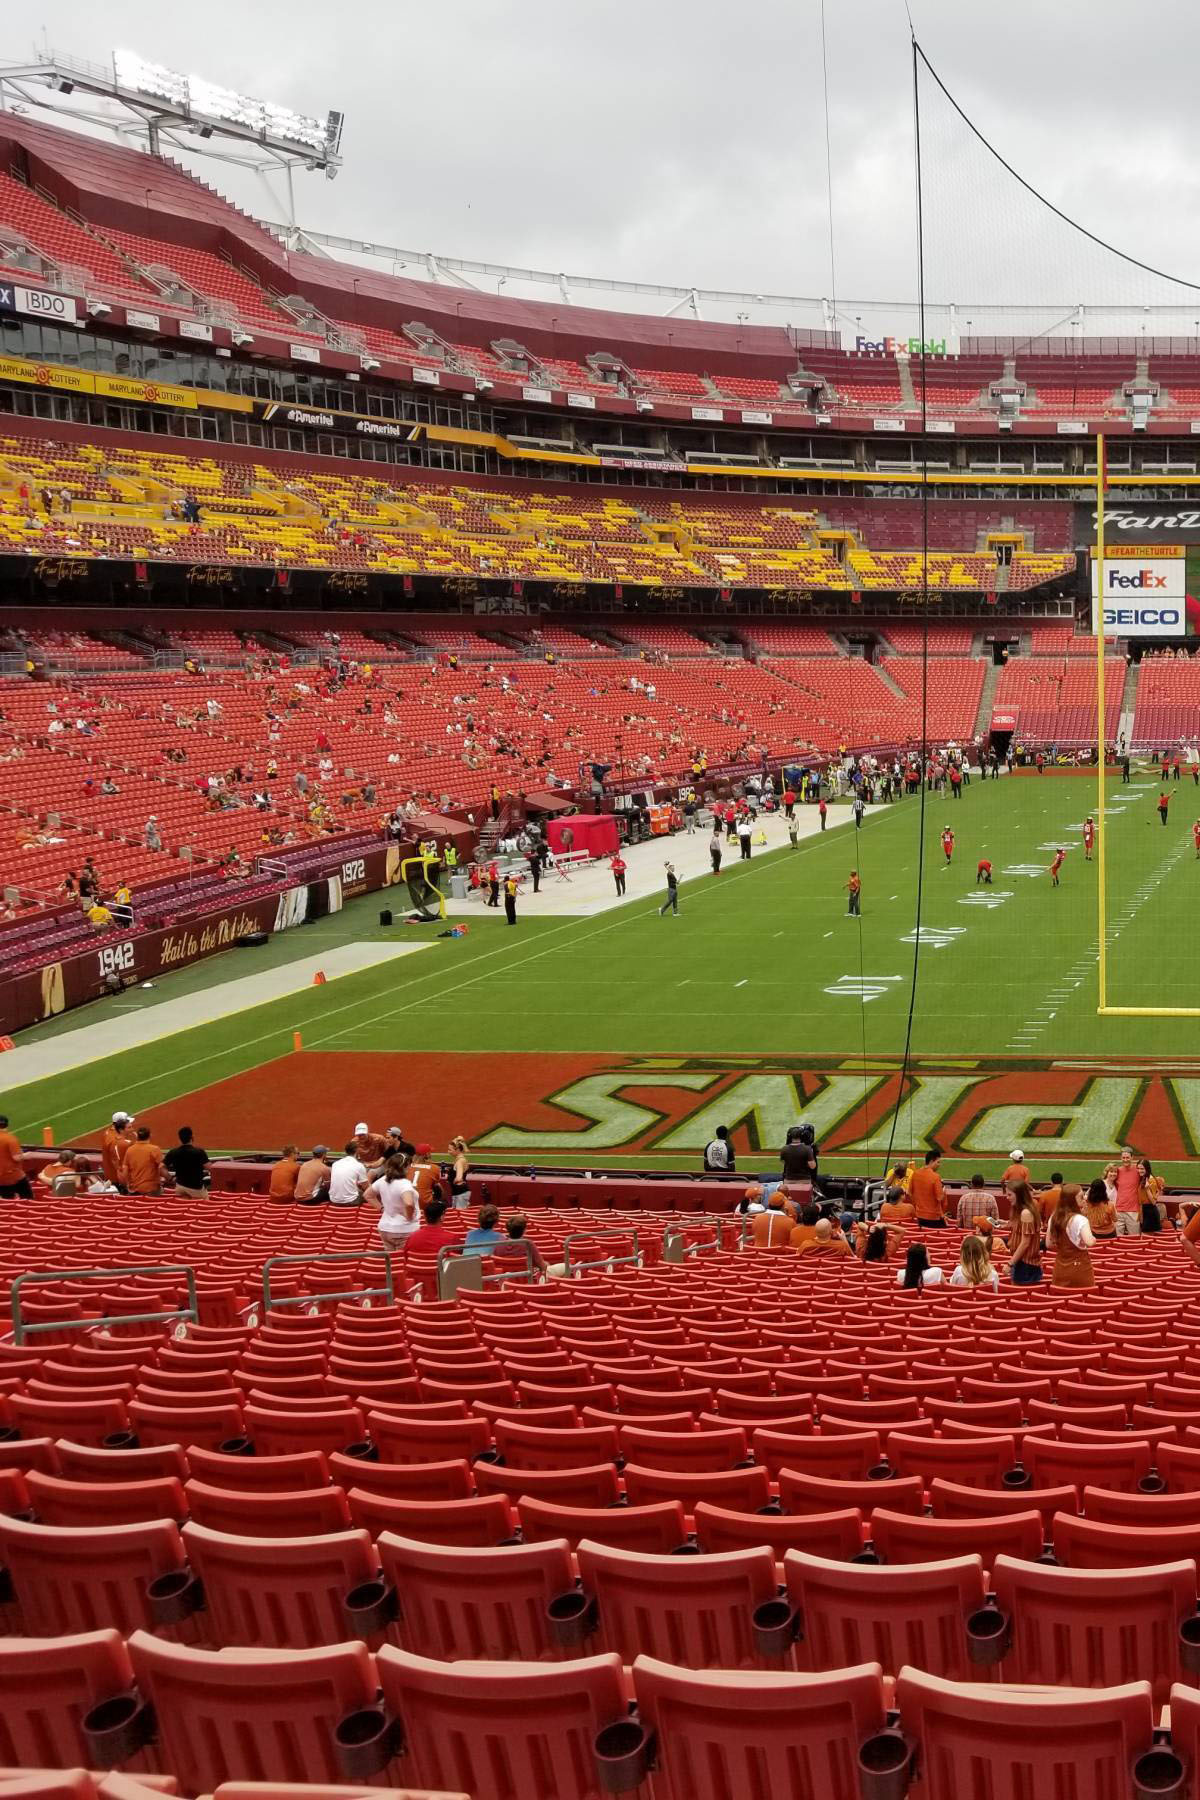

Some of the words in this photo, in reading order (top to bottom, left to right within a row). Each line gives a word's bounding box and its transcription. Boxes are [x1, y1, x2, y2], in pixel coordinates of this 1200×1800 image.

[31, 290, 66, 315] BDO
[855, 335, 947, 354] FedExField
[0, 359, 35, 378] MARYLAND
[52, 374, 81, 387] LOTTERY
[108, 382, 144, 397] MARYLAND
[295, 409, 334, 427] Ameritel
[363, 420, 400, 437] Ameritel
[1110, 546, 1179, 557] #FEARTHETURTLE
[1108, 569, 1168, 589] FedEx
[1101, 609, 1180, 626] GEICO
[341, 858, 366, 884] 1972
[160, 936, 186, 966] Hail
[187, 935, 198, 955] to
[200, 926, 216, 952] the
[97, 941, 135, 977] 1942
